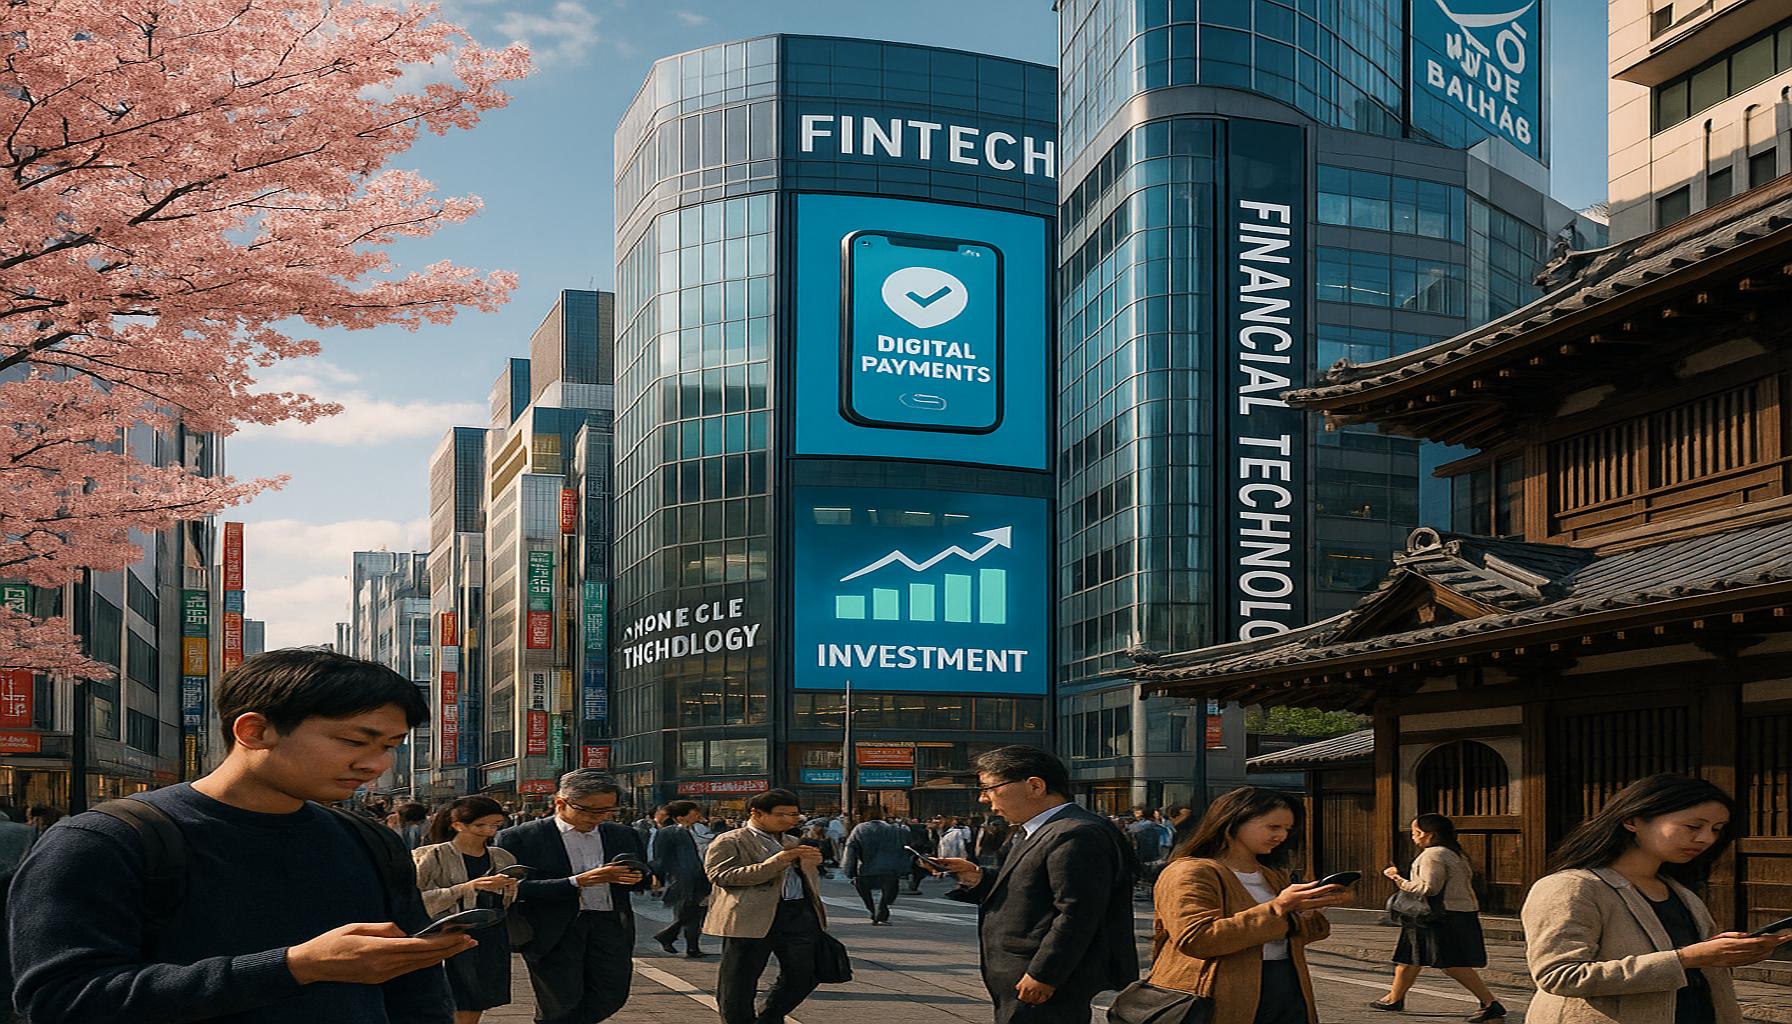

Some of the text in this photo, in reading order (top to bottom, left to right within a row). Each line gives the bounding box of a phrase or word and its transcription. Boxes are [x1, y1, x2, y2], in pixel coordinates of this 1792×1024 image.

[800, 114, 1055, 178] FINTECH
[1239, 200, 1292, 415] FINANCIAL
[877, 335, 976, 360] DIGITAL
[861, 356, 991, 383] PAYMENTS
[817, 643, 1028, 673] INVESTMENT
